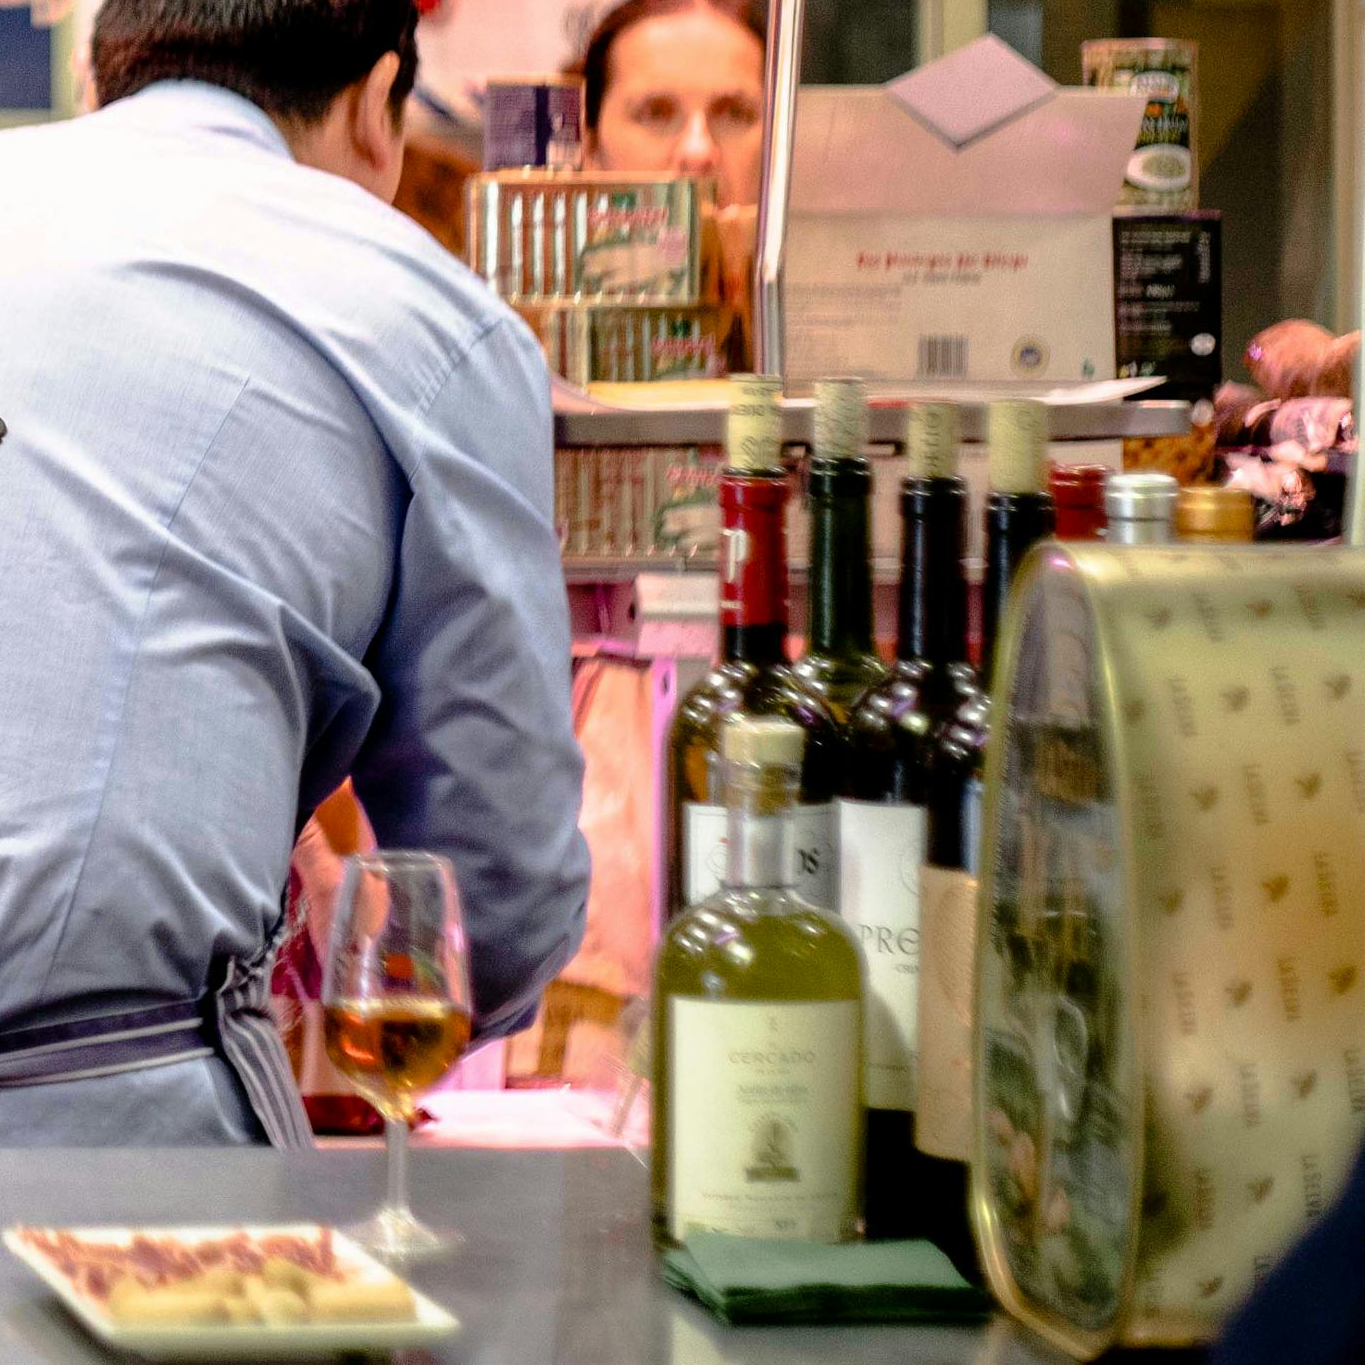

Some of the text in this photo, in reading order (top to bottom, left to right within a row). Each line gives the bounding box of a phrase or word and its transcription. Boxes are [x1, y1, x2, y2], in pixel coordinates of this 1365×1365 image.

[728, 1050, 815, 1065] CERCADO
[1300, 1154, 1322, 1219] LA SELVA
